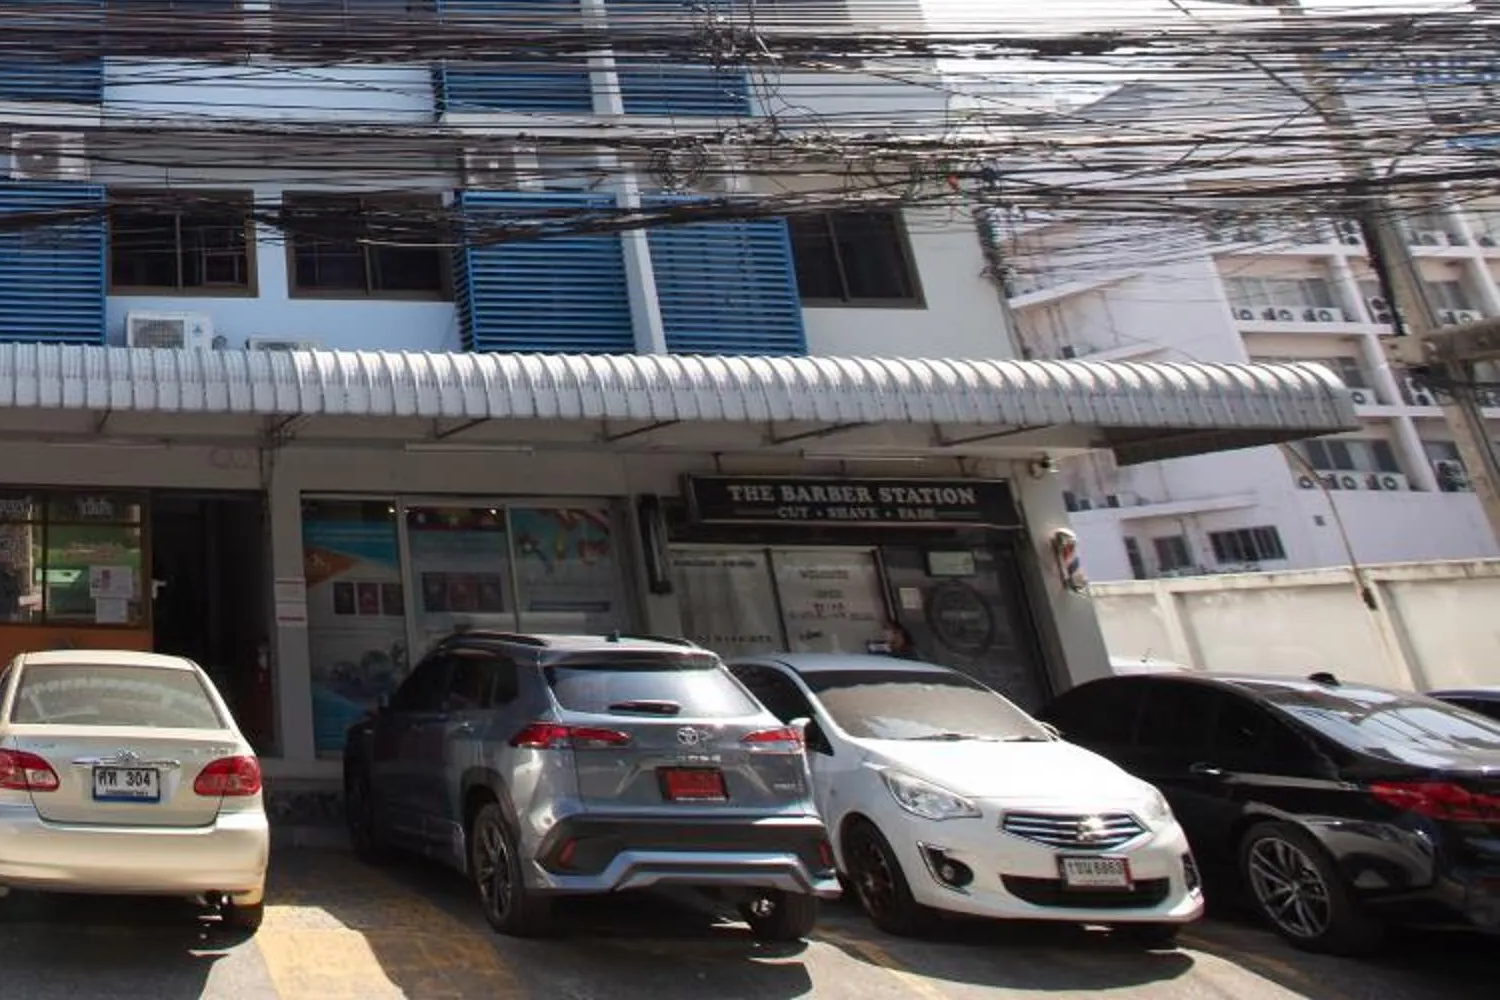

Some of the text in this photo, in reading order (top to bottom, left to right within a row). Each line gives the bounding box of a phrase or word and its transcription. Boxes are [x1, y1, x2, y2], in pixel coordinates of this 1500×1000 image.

[726, 485, 977, 505] THE BARBER STATION
[777, 507, 808, 519] CUT
[827, 507, 879, 519] SHAVE
[125, 770, 151, 787] 304
